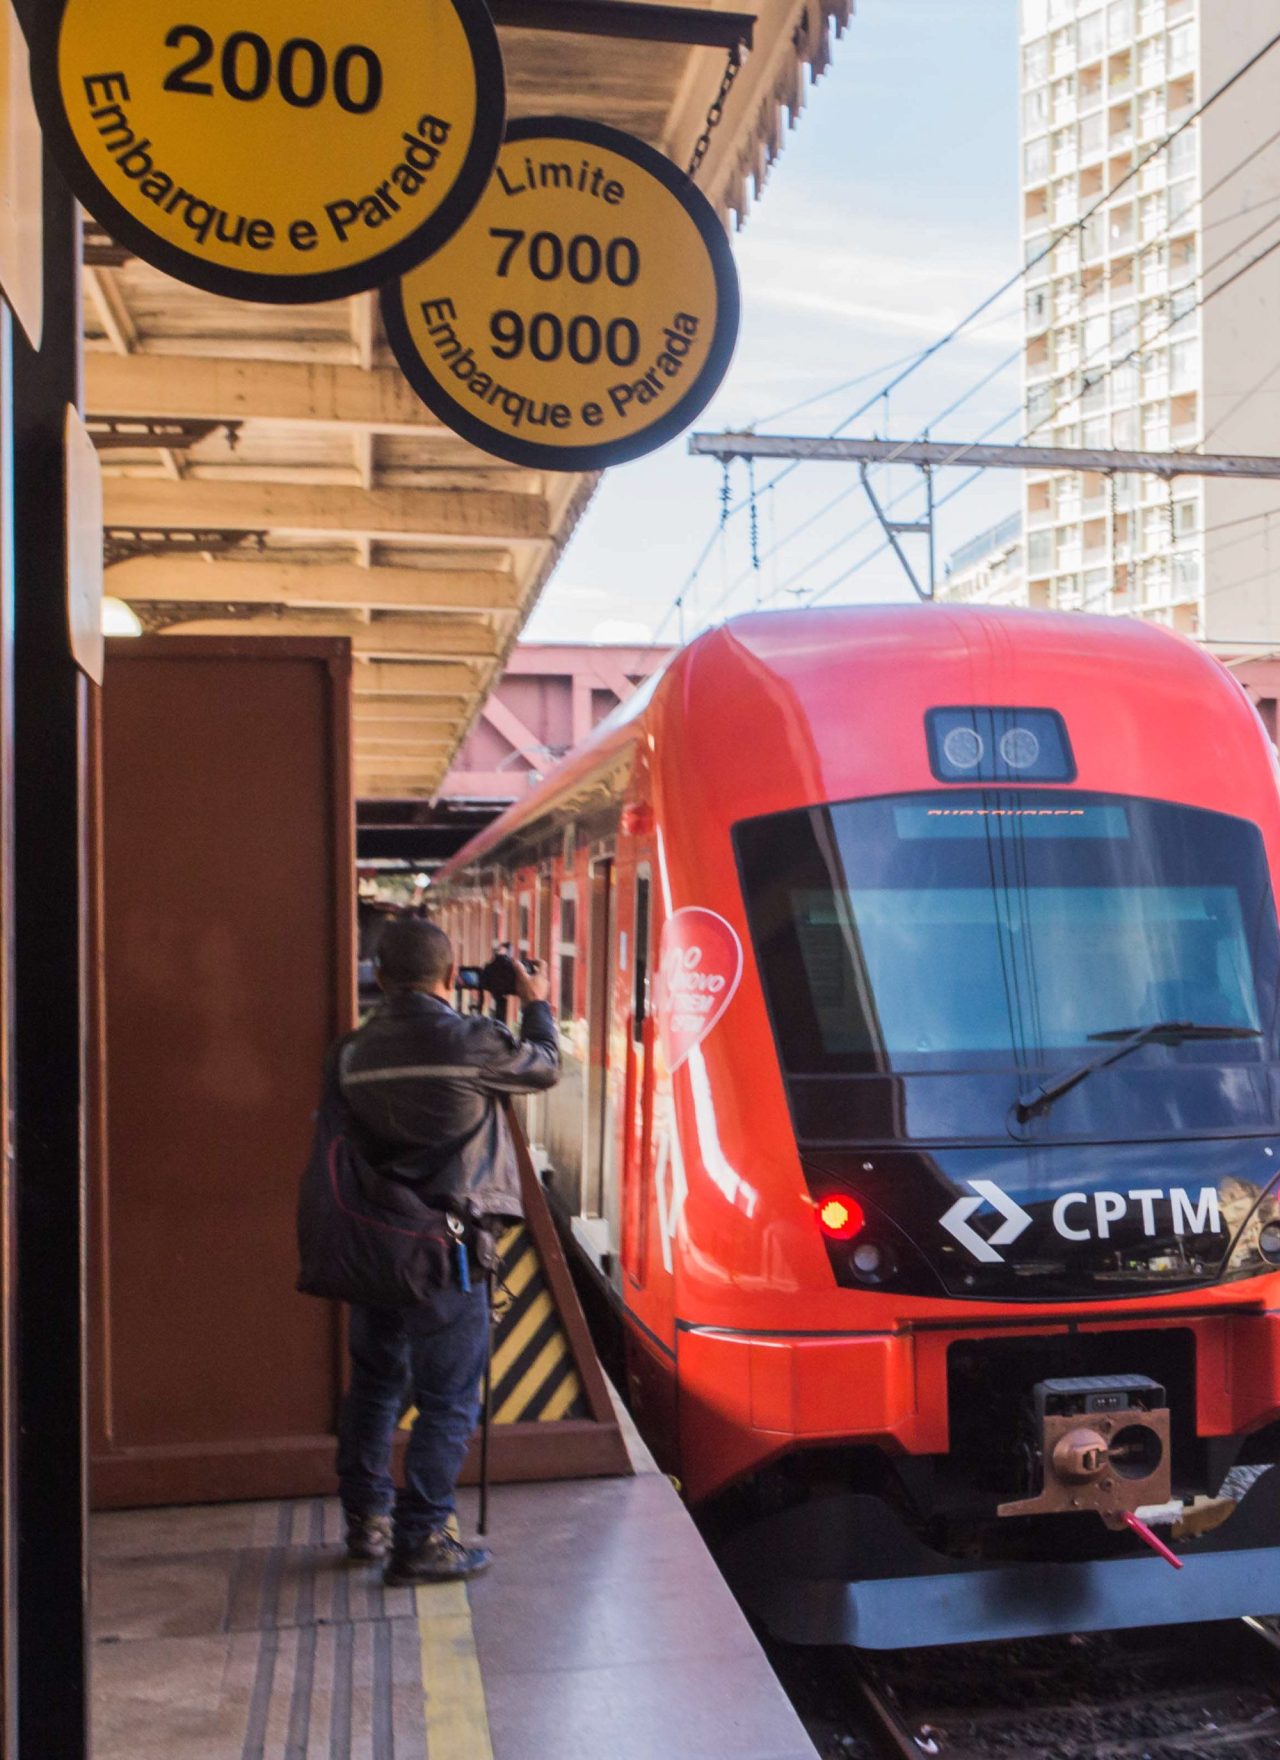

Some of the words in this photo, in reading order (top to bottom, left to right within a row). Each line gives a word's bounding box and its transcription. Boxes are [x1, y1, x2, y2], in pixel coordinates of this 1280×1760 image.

[162, 24, 383, 115] 2000
[82, 72, 275, 249] Embarque
[288, 219, 318, 250] e
[324, 114, 452, 242] Parada
[496, 157, 625, 205] Limite
[489, 228, 640, 287] 7000
[420, 297, 572, 428] Embarque
[581, 402, 604, 426] e
[607, 311, 699, 417] Parada
[489, 309, 640, 367] 9000
[1052, 1187, 1221, 1241] CPTM
